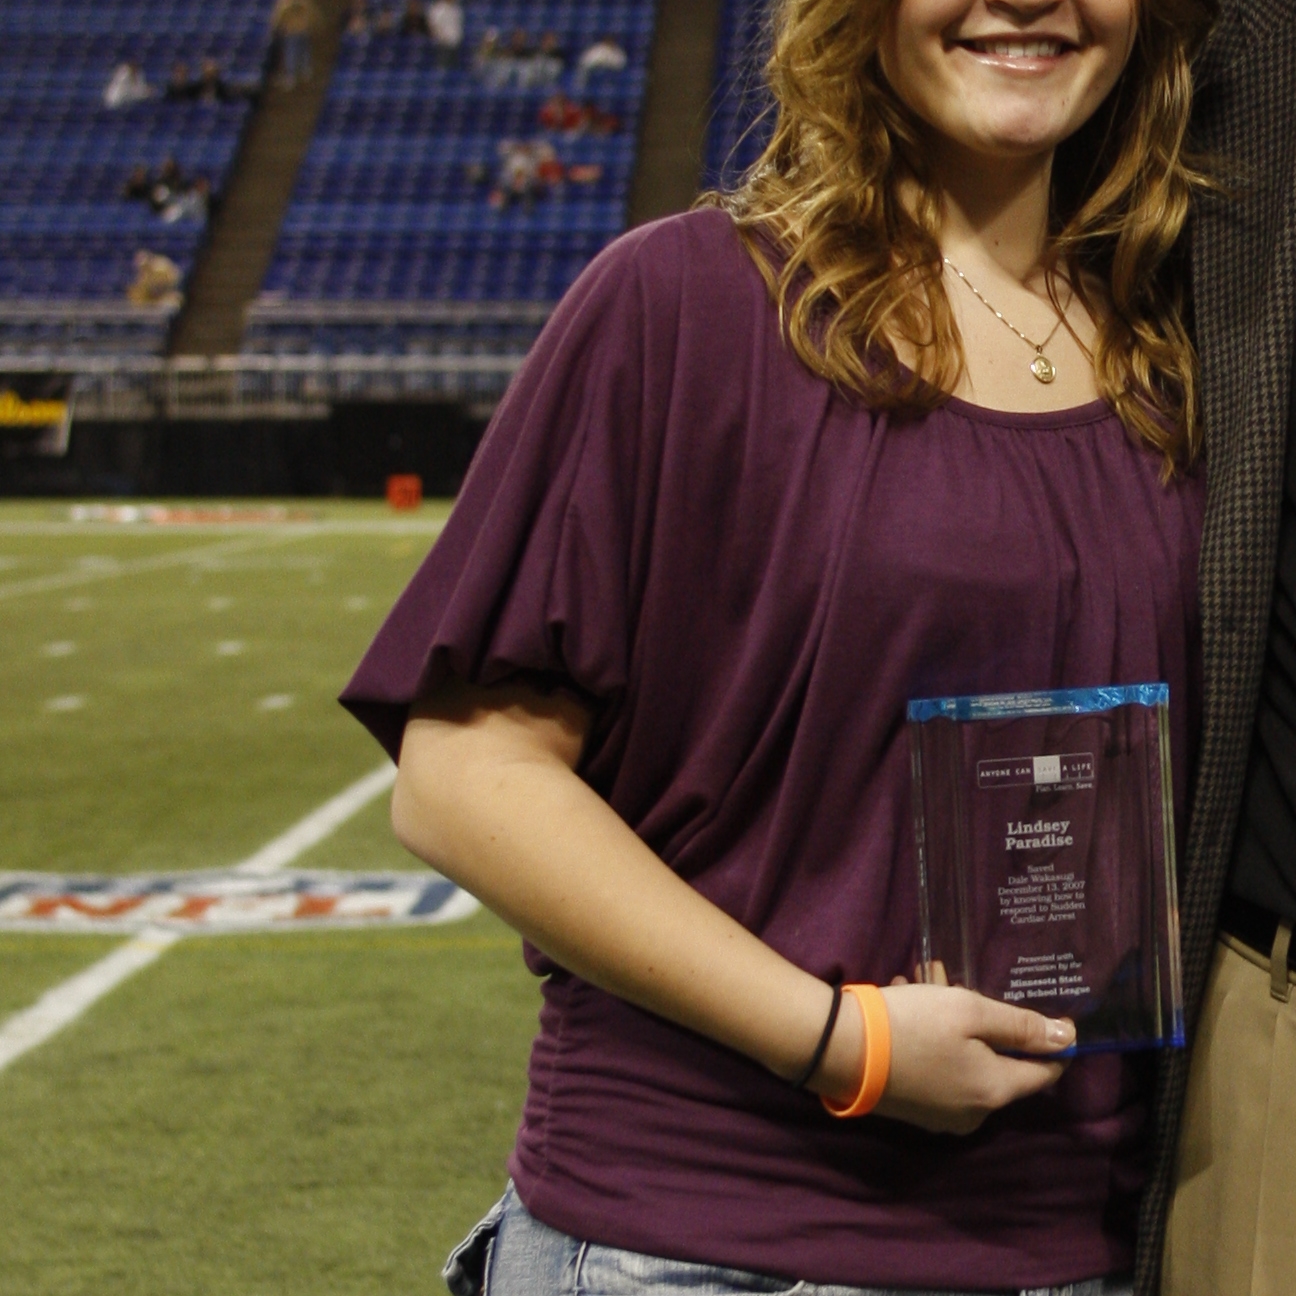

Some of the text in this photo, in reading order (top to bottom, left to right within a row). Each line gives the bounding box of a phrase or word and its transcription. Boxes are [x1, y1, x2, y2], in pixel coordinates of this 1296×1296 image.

[980, 768, 1011, 778] ANYONE
[1015, 767, 1031, 776] CAN
[1071, 762, 1091, 772] LIFE
[1007, 820, 1070, 835] Lindsey
[1005, 834, 1073, 851] Paradise
[1027, 863, 1054, 873] Saved
[1008, 875, 1029, 885] Dale
[998, 885, 1043, 896] December
[1062, 880, 1085, 891] 2007
[1000, 891, 1085, 906] by knowing how to
[1000, 901, 1085, 916] respond to Sudden
[1010, 912, 1075, 924] Cardiac Arrest
[1017, 952, 1074, 964] Presented with
[1058, 962, 1068, 971] by
[1010, 975, 1083, 988] Minnesota State
[1004, 986, 1090, 1001] High School League
